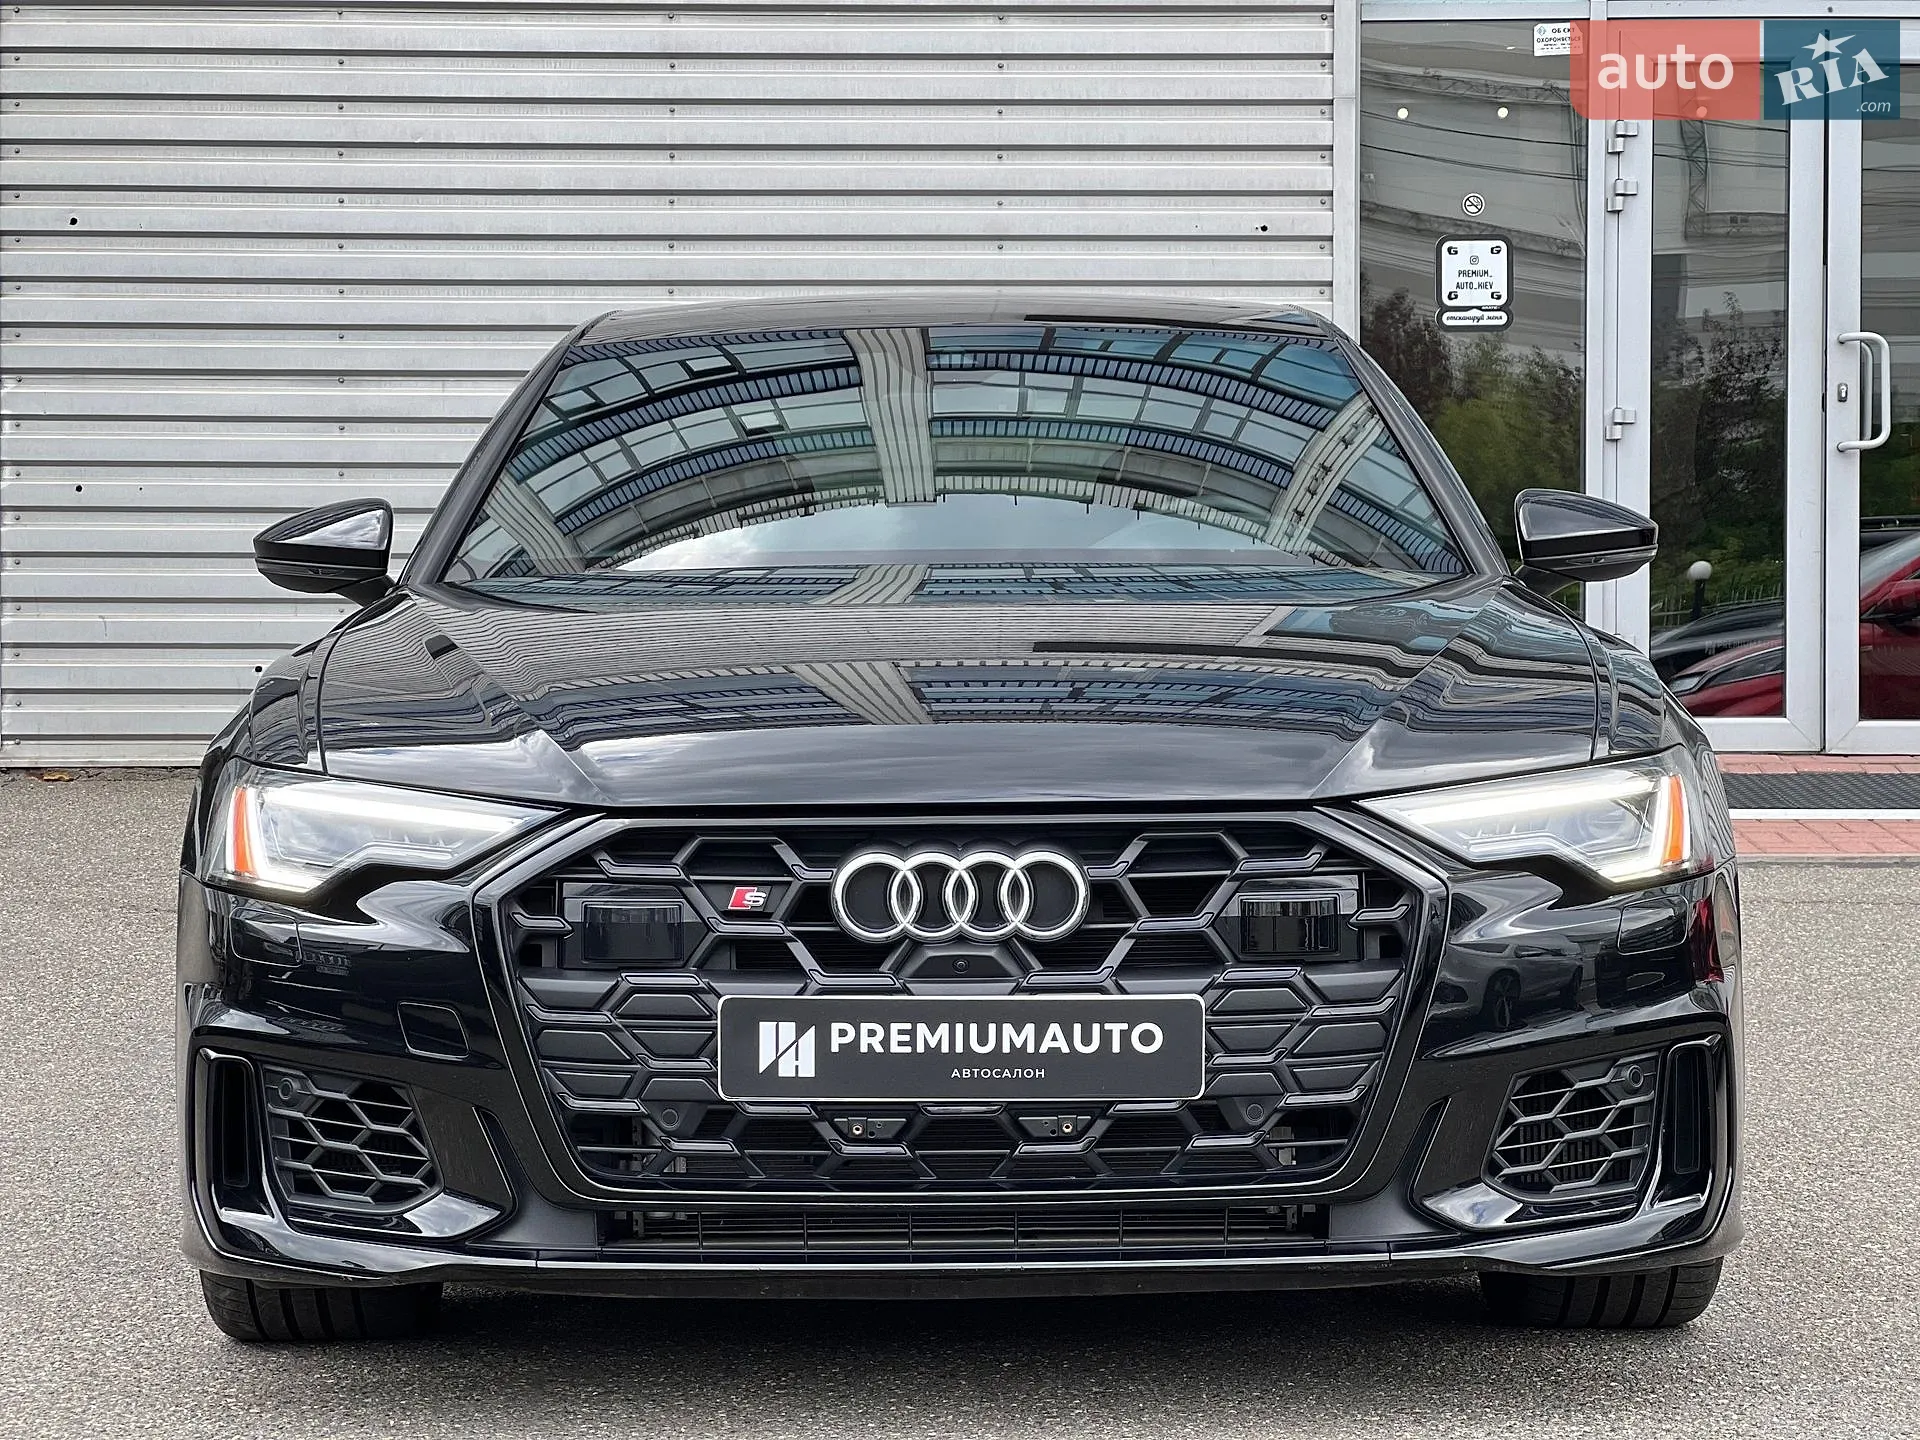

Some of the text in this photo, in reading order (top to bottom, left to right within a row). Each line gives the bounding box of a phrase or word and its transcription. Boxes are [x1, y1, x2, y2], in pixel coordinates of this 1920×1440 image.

[1456, 281, 1494, 290] AUTO_KIEV
[830, 1022, 1164, 1054] PREMIUMAUTO
[950, 1068, 1046, 1079] АВТОСАЛОН
